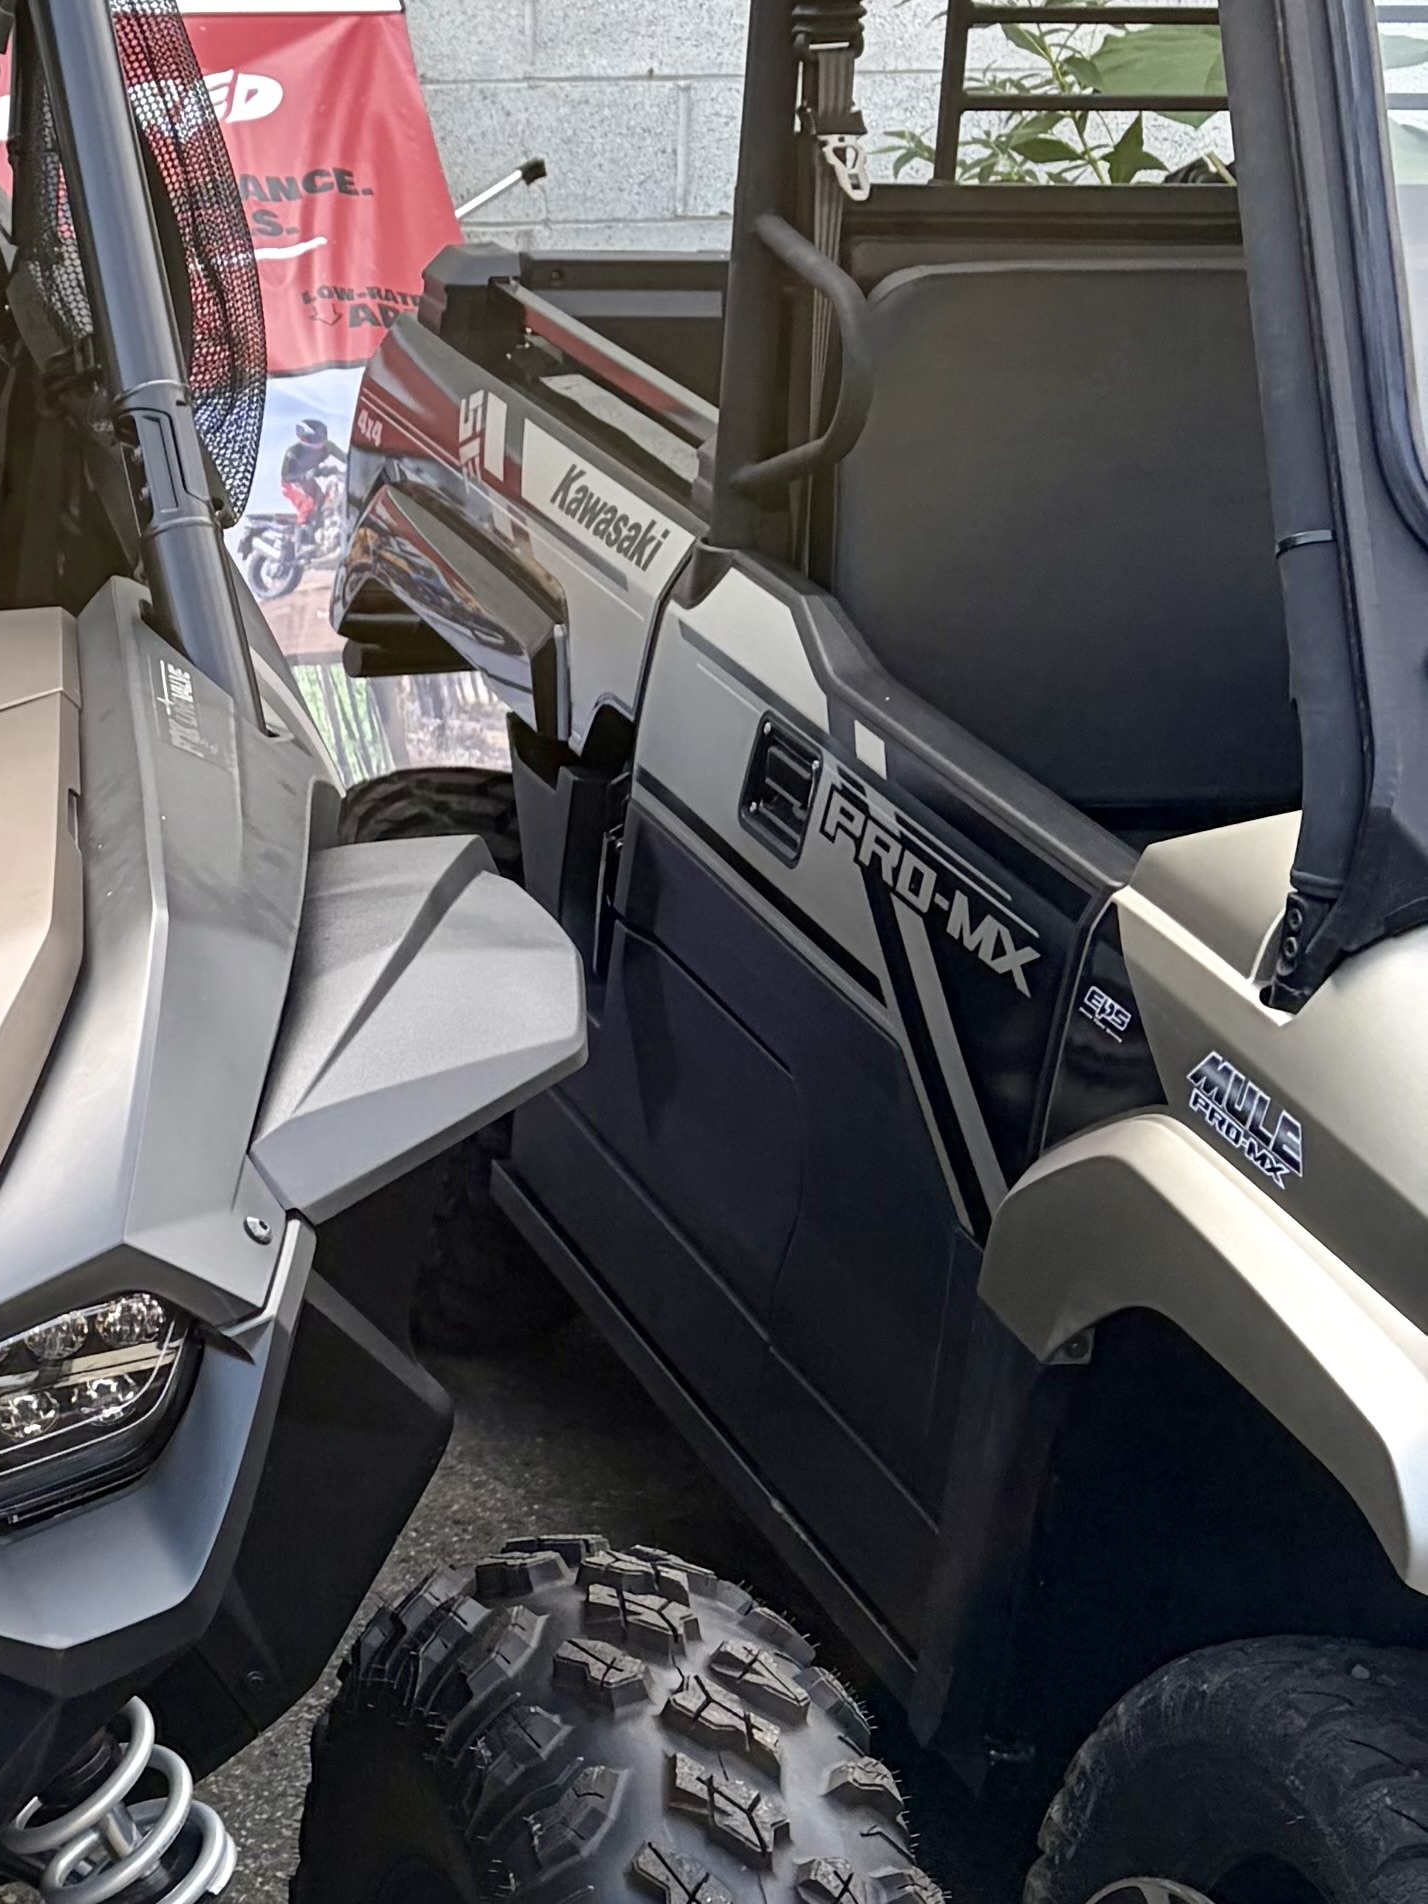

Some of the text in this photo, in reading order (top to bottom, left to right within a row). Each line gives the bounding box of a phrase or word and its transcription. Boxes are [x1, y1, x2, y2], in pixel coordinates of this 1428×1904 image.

[239, 167, 374, 203] ANCE.
[251, 209, 300, 237] S.
[550, 463, 671, 572] Kawasaki
[823, 791, 1042, 998] PRO-MX
[1084, 985, 1132, 1032] EPS
[1186, 1050, 1303, 1178] MULE
[1189, 1087, 1291, 1190] PRO-MX
